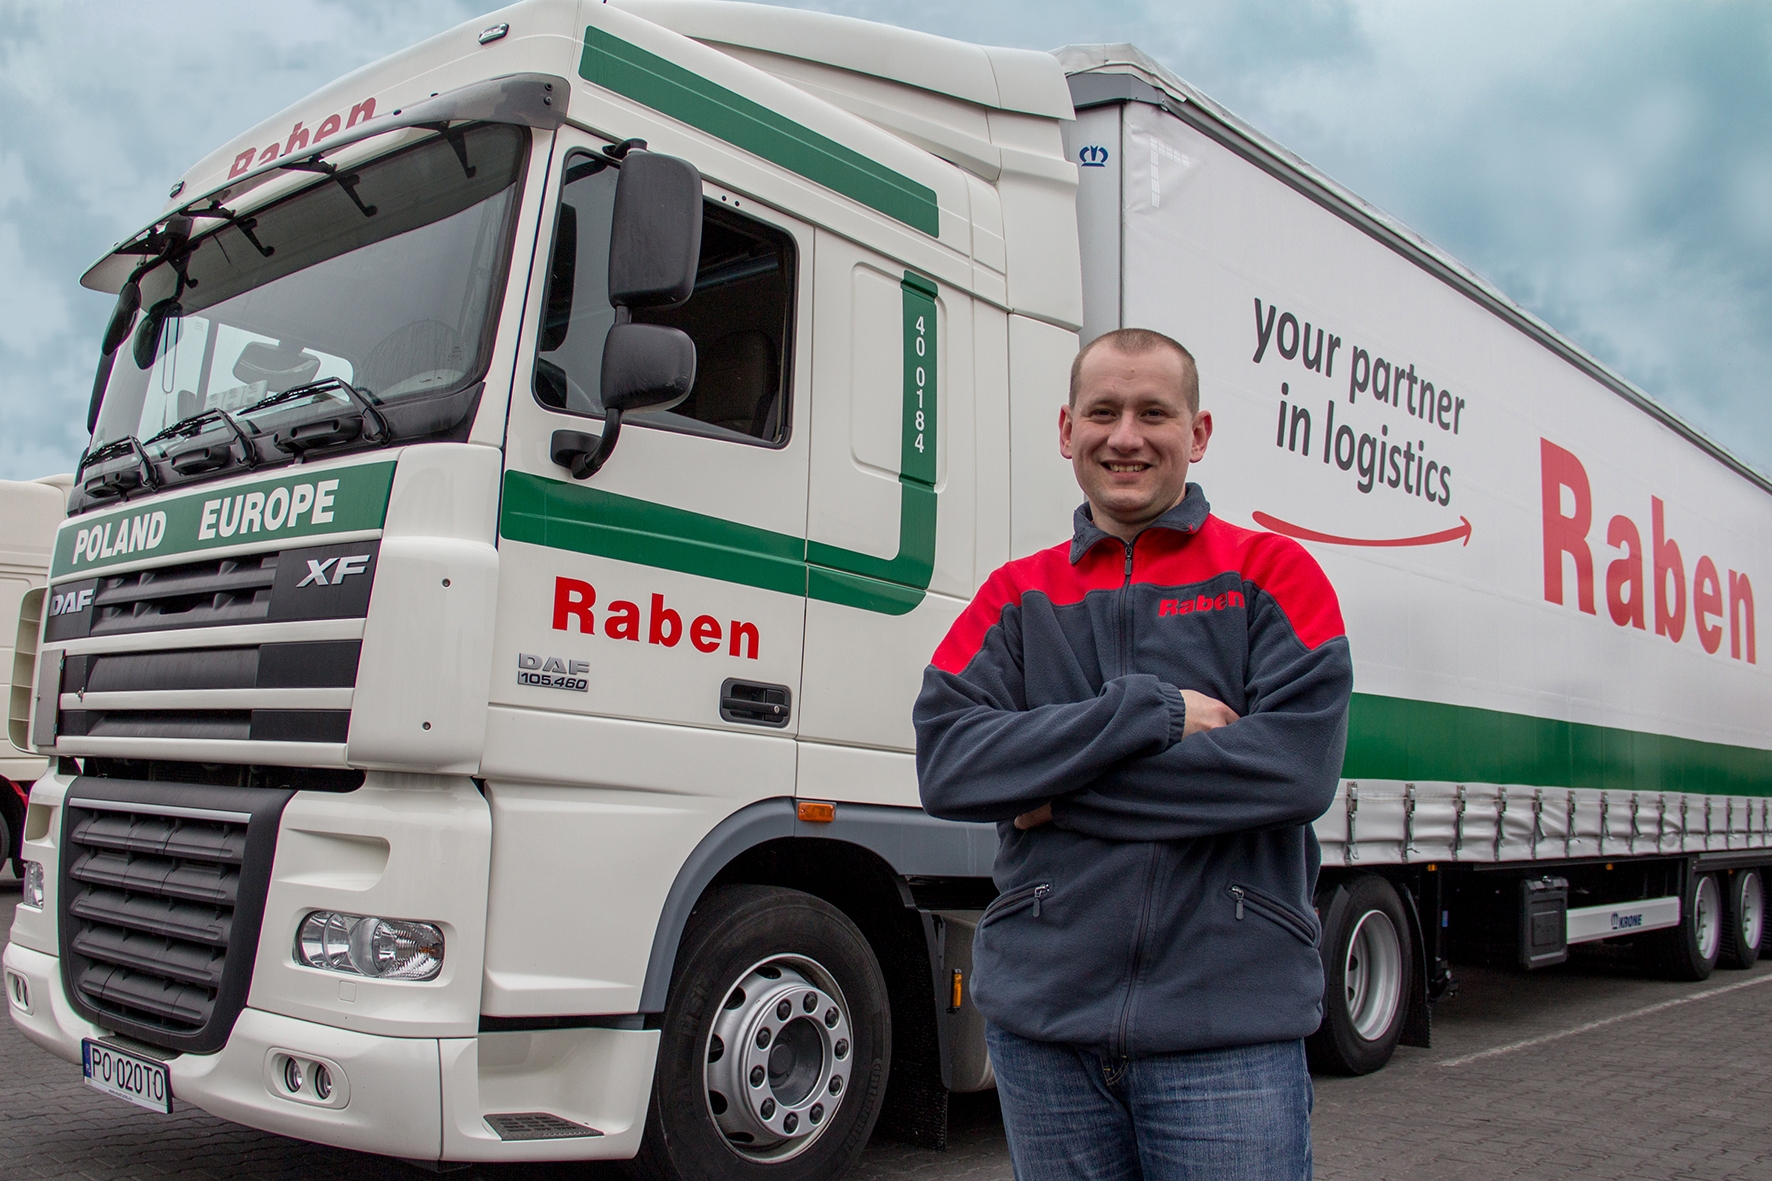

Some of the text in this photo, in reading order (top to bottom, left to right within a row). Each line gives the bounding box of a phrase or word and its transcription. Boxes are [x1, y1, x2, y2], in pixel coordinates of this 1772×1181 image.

[914, 315, 926, 454] 40 0184
[1252, 297, 1465, 435] your partner
[1276, 382, 1452, 507] in logistics
[72, 478, 340, 565] POLAND EUROPE
[296, 554, 371, 588] XF
[1539, 436, 1757, 666] Raben
[49, 588, 95, 617] DAF
[552, 575, 760, 661] Raben
[1157, 589, 1246, 617] Raben
[518, 652, 590, 676] DAF
[519, 672, 588, 691] 105.460
[1619, 913, 1643, 929] KRONE
[92, 1047, 164, 1101] PO 020TO
